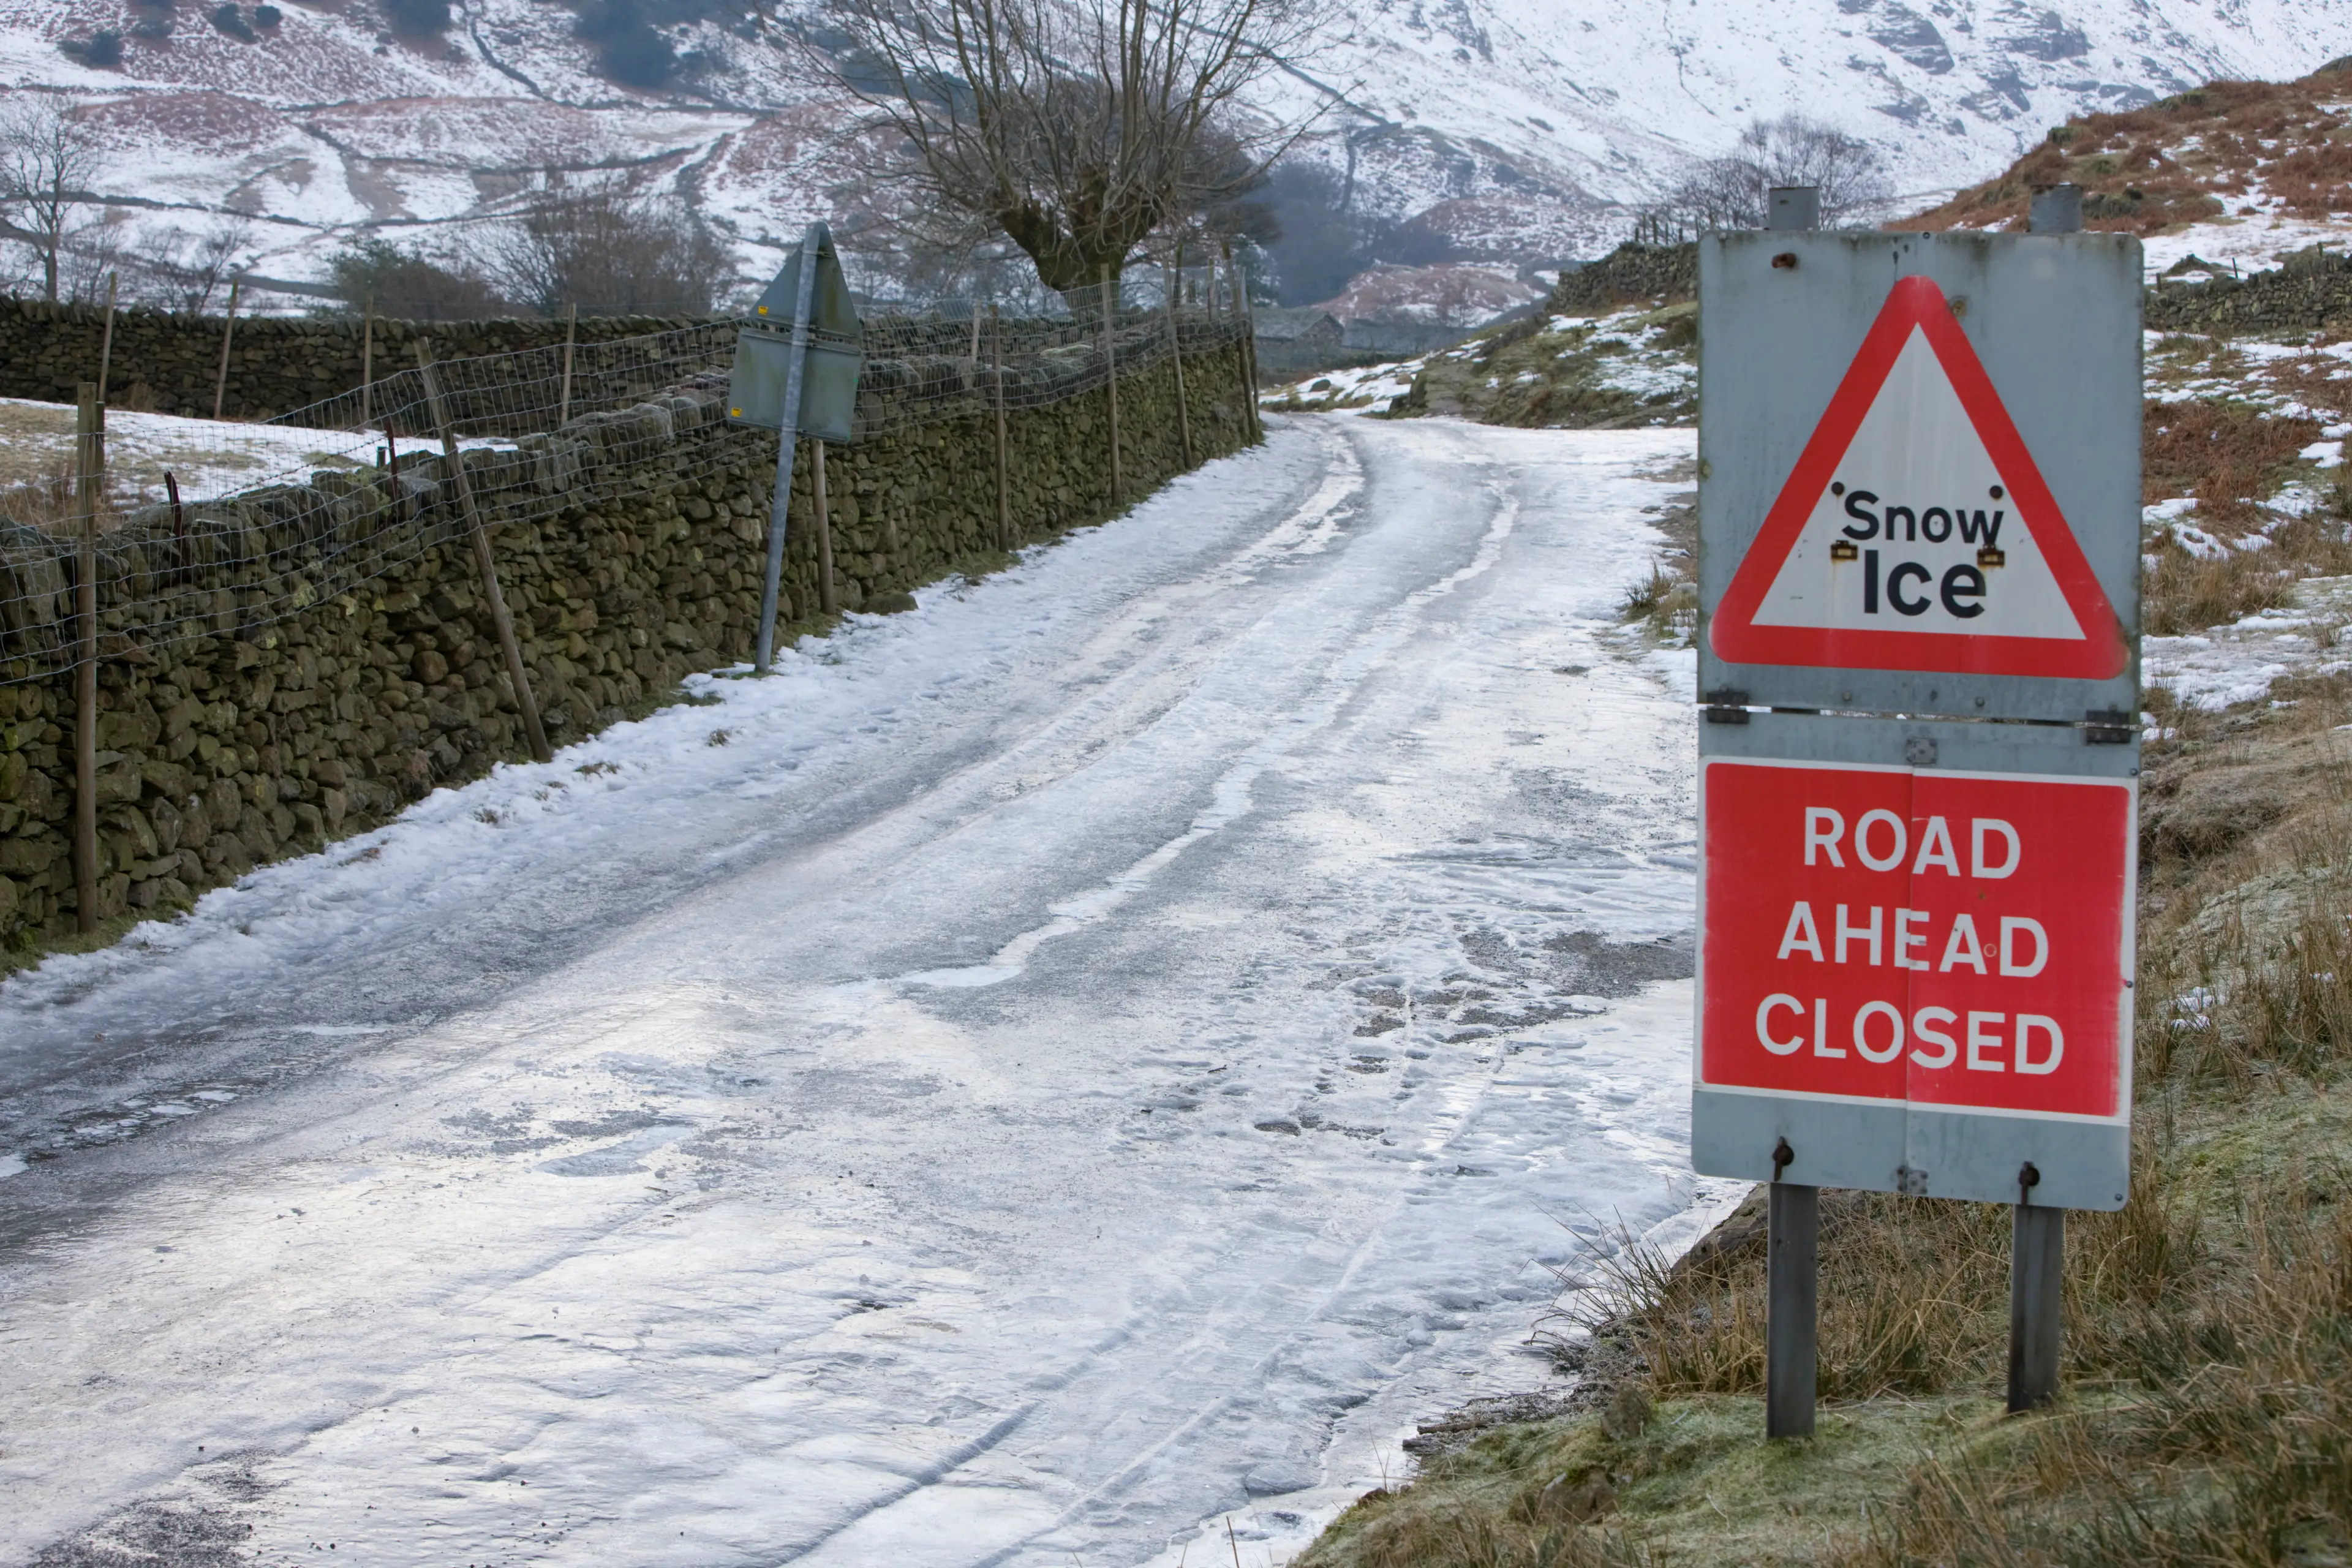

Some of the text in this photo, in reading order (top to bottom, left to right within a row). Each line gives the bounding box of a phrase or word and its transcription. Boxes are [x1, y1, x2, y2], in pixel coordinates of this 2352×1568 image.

[1841, 490, 2004, 544] Snow
[1864, 549, 1986, 619] Ice
[1804, 807, 2021, 879] ROAD
[1777, 901, 2049, 978] AHEAD
[1755, 993, 2064, 1075] CLOSED
